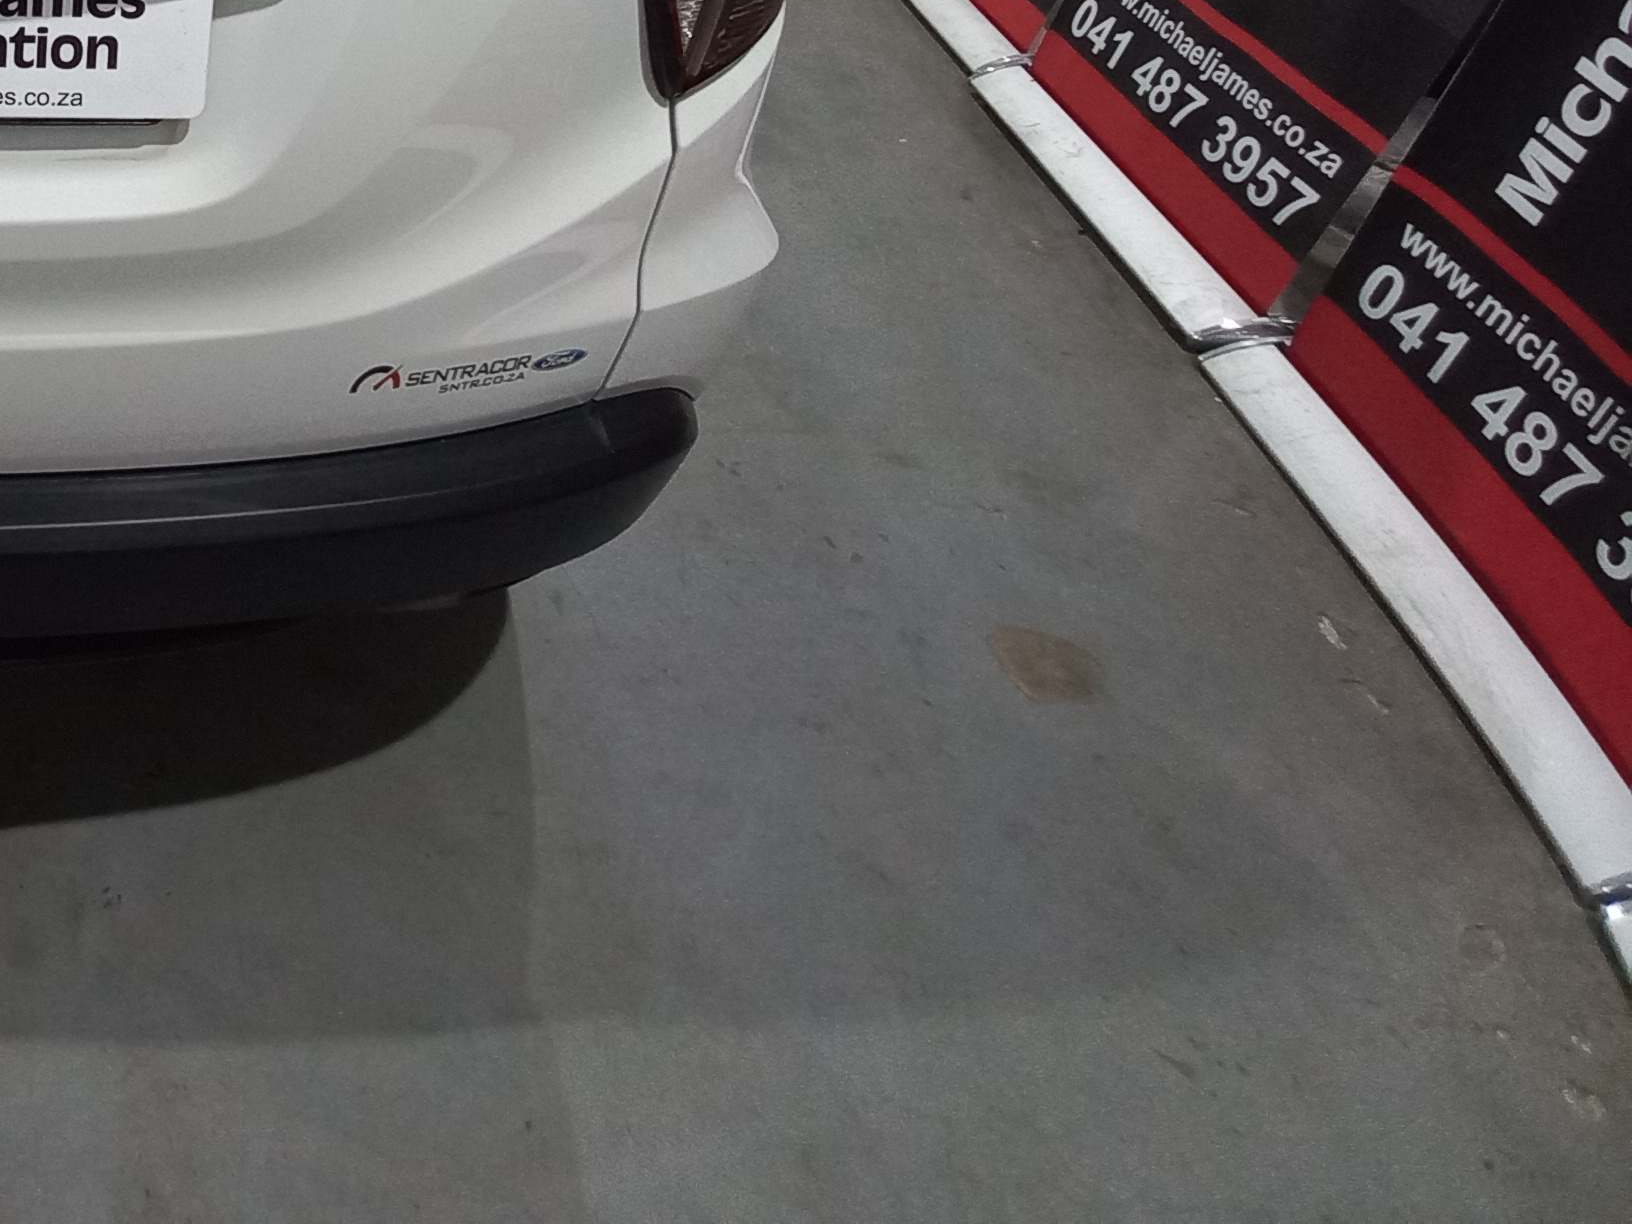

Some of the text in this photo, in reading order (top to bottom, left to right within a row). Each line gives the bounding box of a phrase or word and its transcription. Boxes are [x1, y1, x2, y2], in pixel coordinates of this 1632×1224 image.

[1131, 56, 1209, 129] 487
[1201, 115, 1321, 226] 3957
[405, 354, 532, 387] SENTRACOR
[1358, 264, 1605, 506] 041 487
[1399, 223, 1632, 467] www.michaelja
